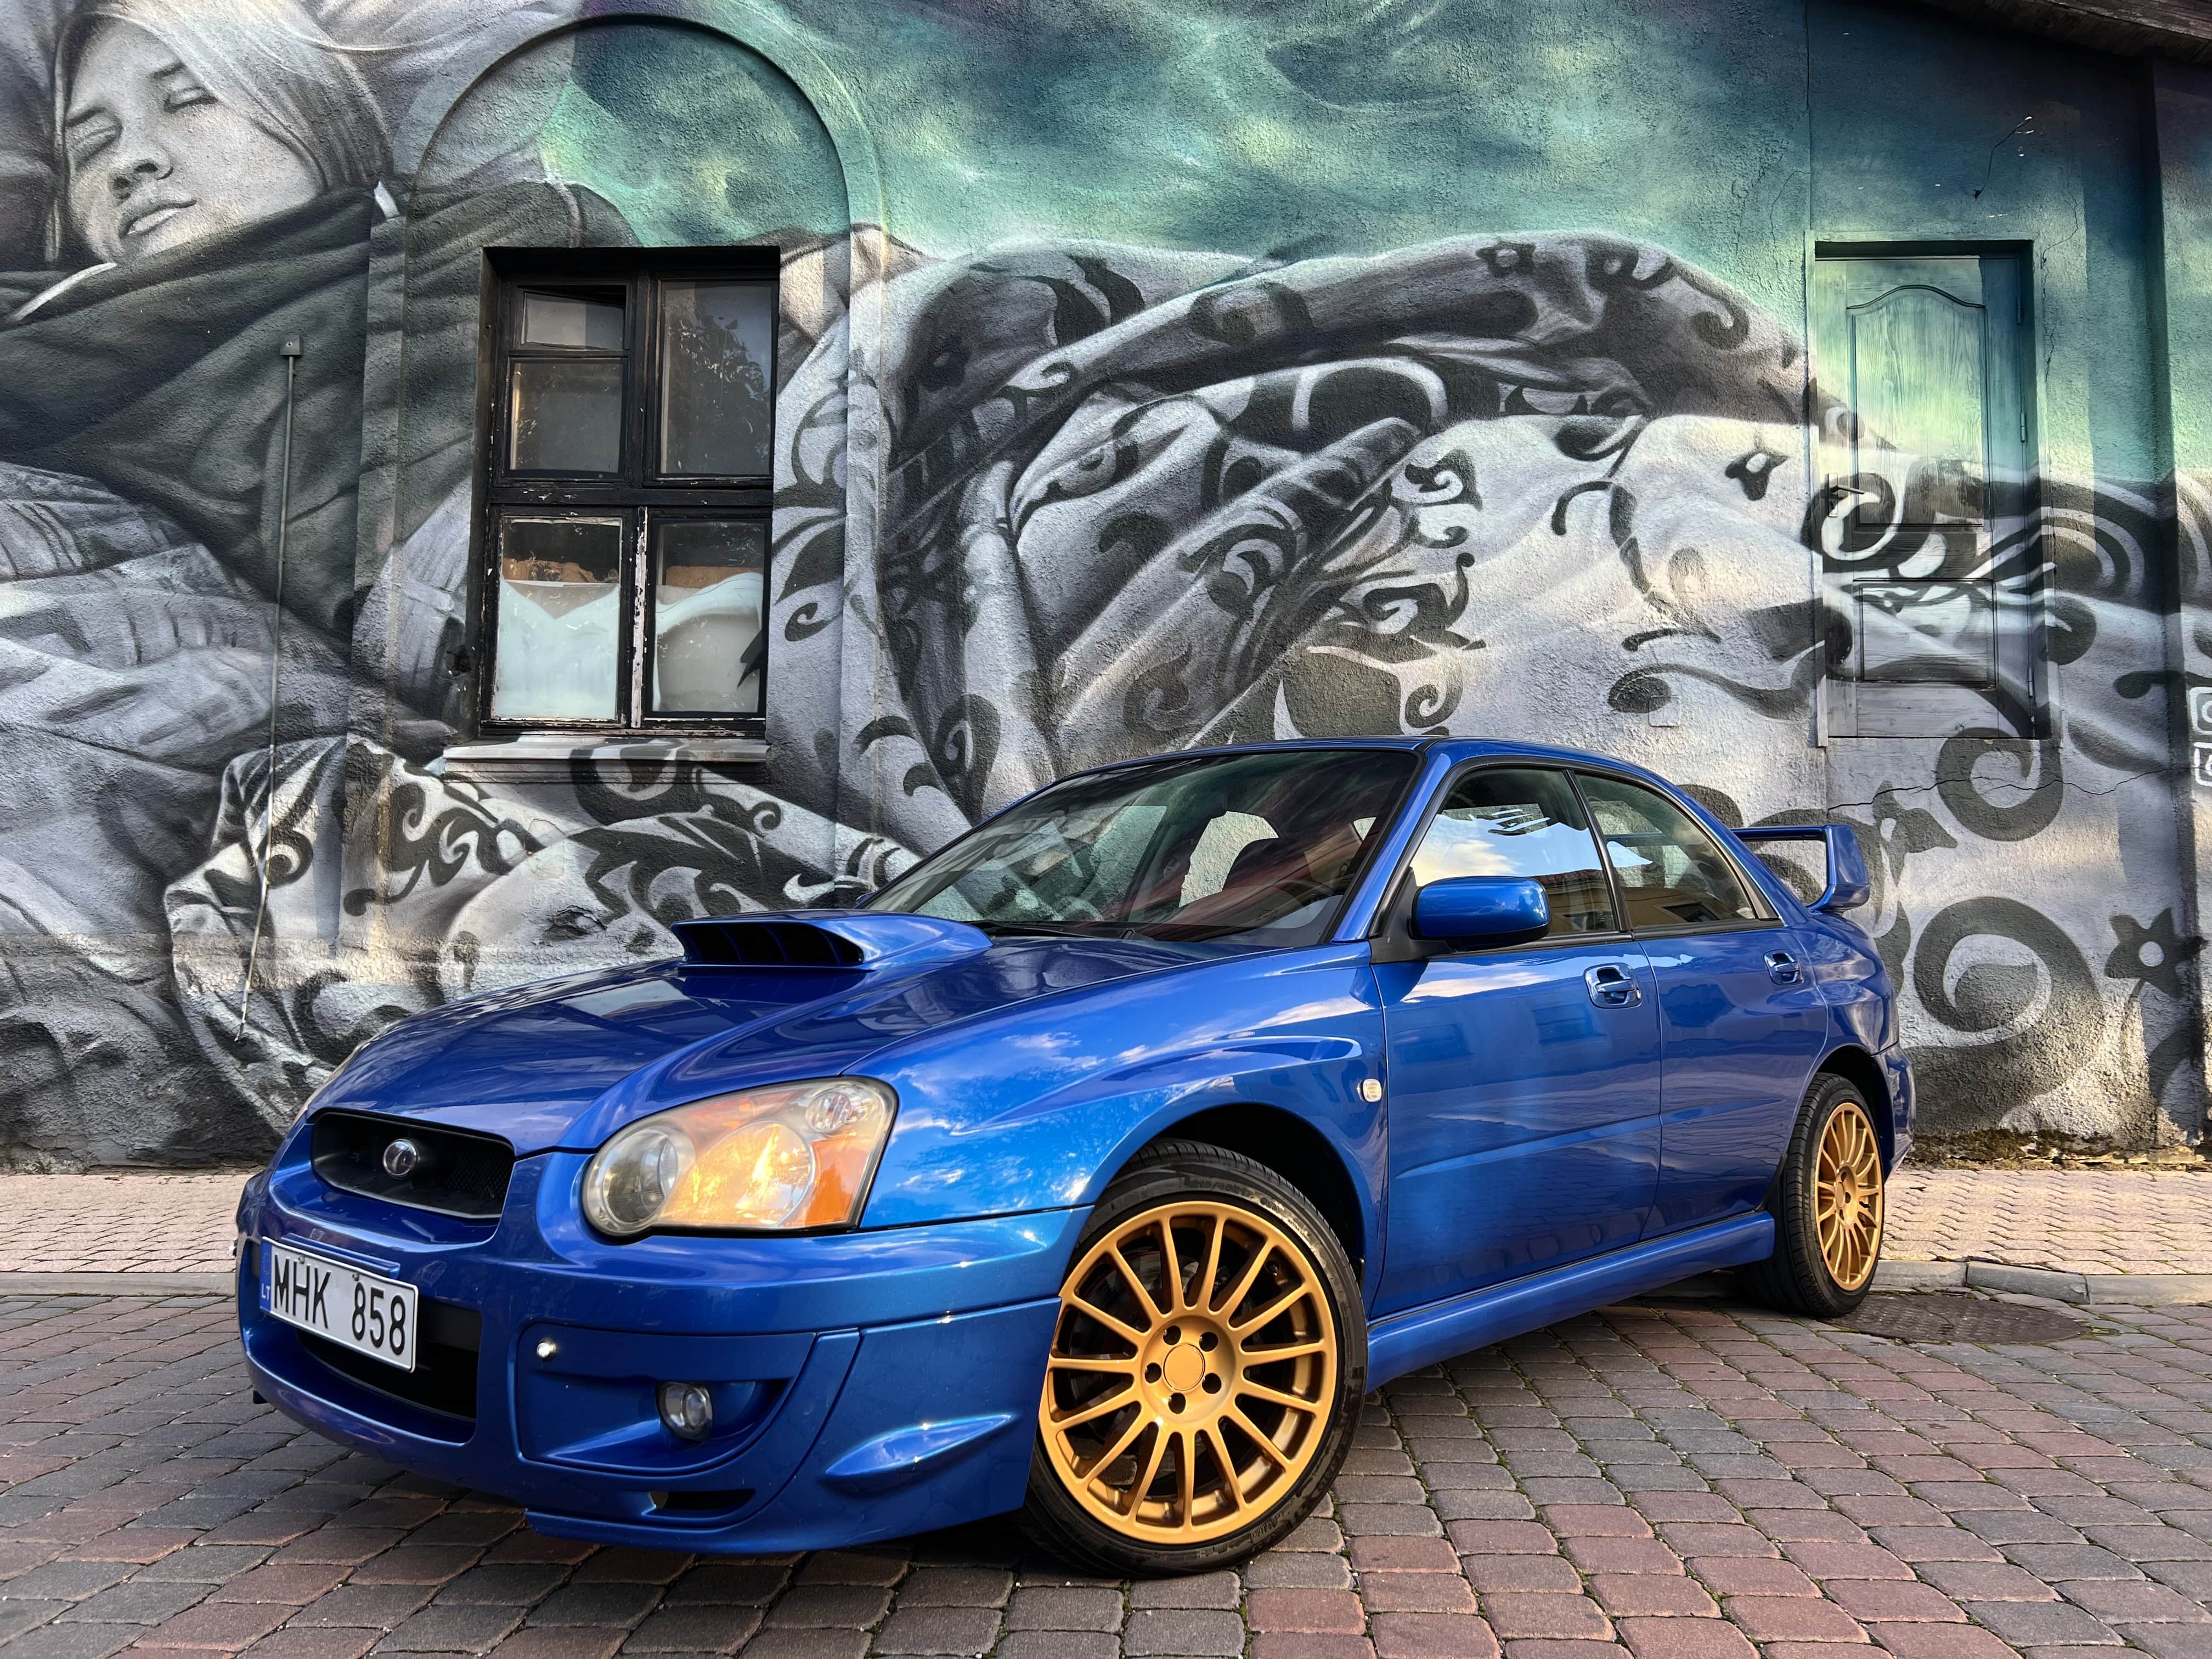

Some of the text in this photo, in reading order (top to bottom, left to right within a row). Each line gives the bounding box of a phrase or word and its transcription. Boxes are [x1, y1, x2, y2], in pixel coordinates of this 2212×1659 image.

[261, 1283, 270, 1301] LT
[274, 1254, 407, 1356] MHK 858
